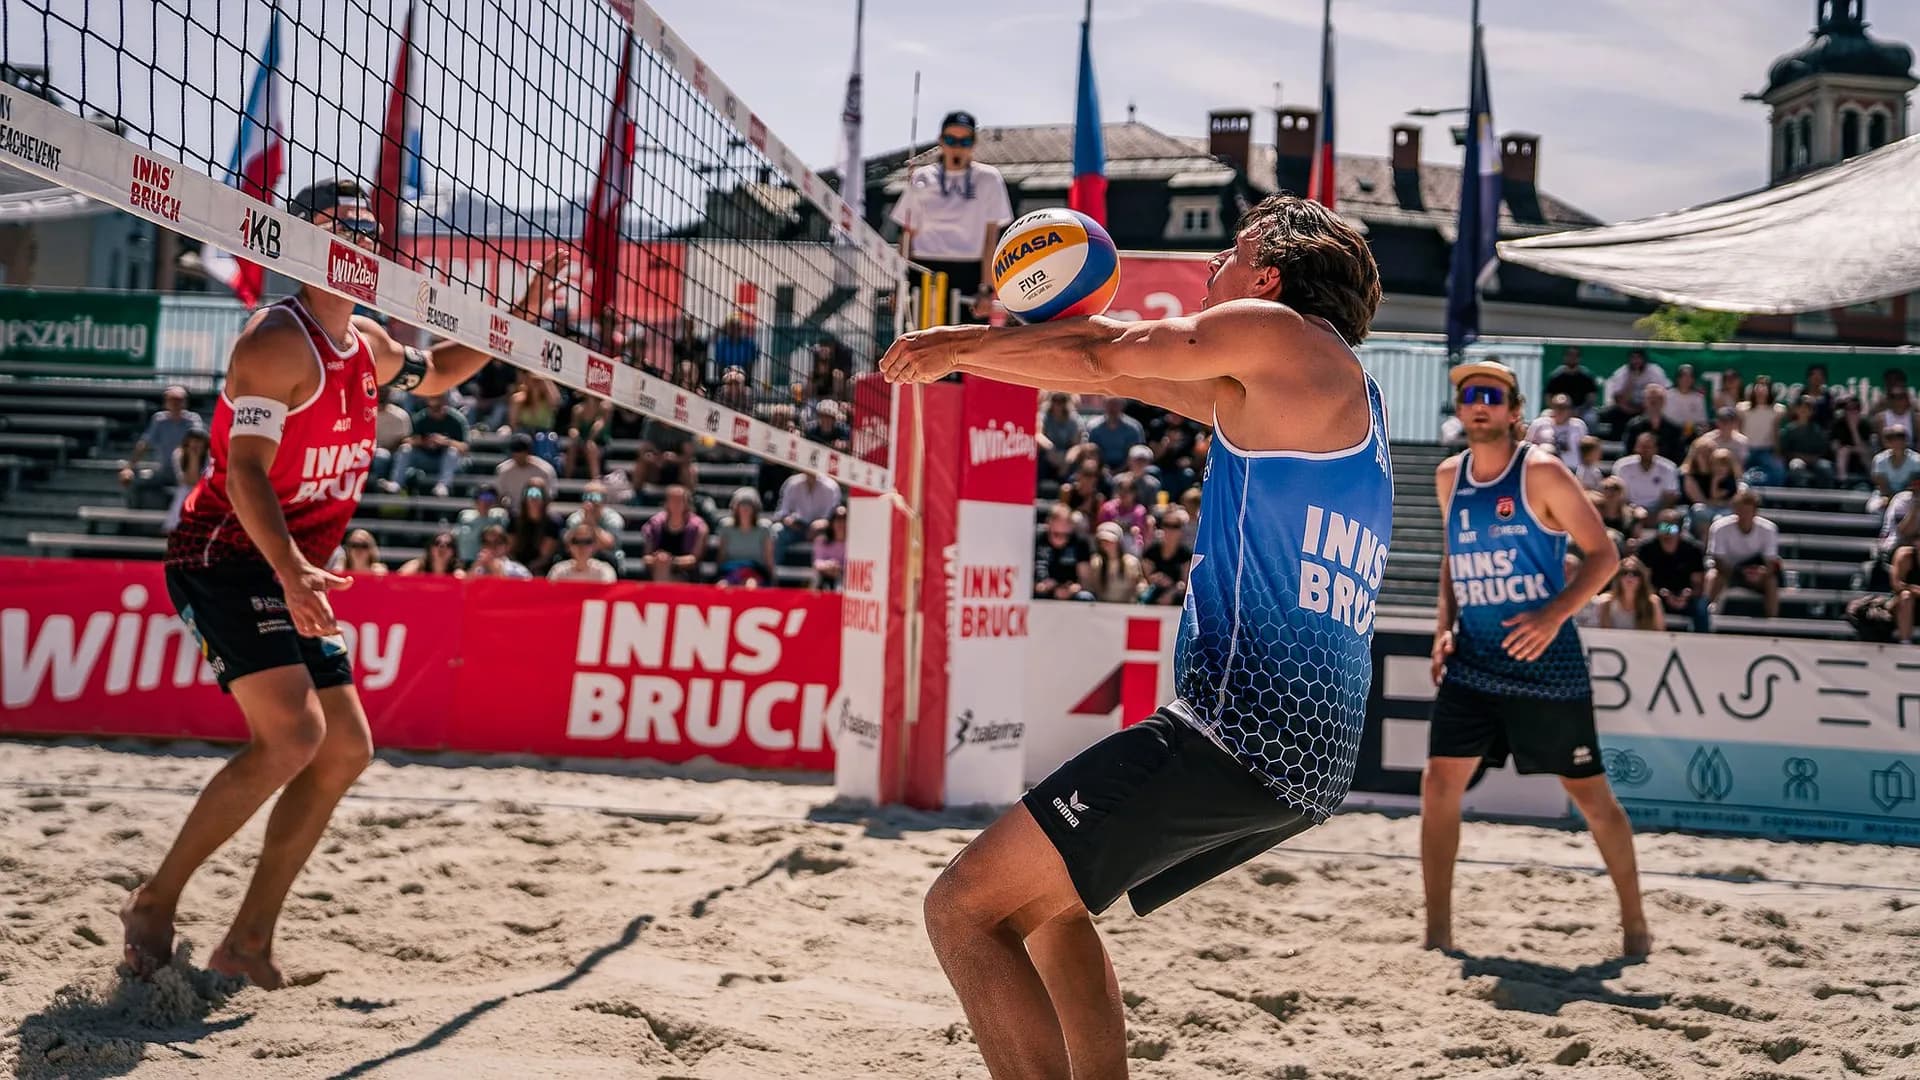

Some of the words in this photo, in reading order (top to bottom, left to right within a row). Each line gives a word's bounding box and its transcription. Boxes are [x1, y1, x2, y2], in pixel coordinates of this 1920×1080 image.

[0, 124, 61, 172] EACHEVENT
[132, 154, 175, 191] INNS'
[129, 181, 182, 223] BRUCK
[332, 252, 377, 290] win2day
[0, 314, 148, 358] eszeitung
[236, 416, 261, 426] NOE
[238, 406, 272, 419] HYPO
[970, 419, 1037, 466] win2day
[287, 470, 369, 505] BRUC
[1458, 508, 1470, 531] 1
[1301, 504, 1389, 591] INNS
[1298, 559, 1377, 641] BRU
[1452, 573, 1550, 608] BRUCK
[575, 599, 808, 675] INNS'
[961, 603, 1030, 638] BRUCK
[1052, 796, 1080, 828] erima
